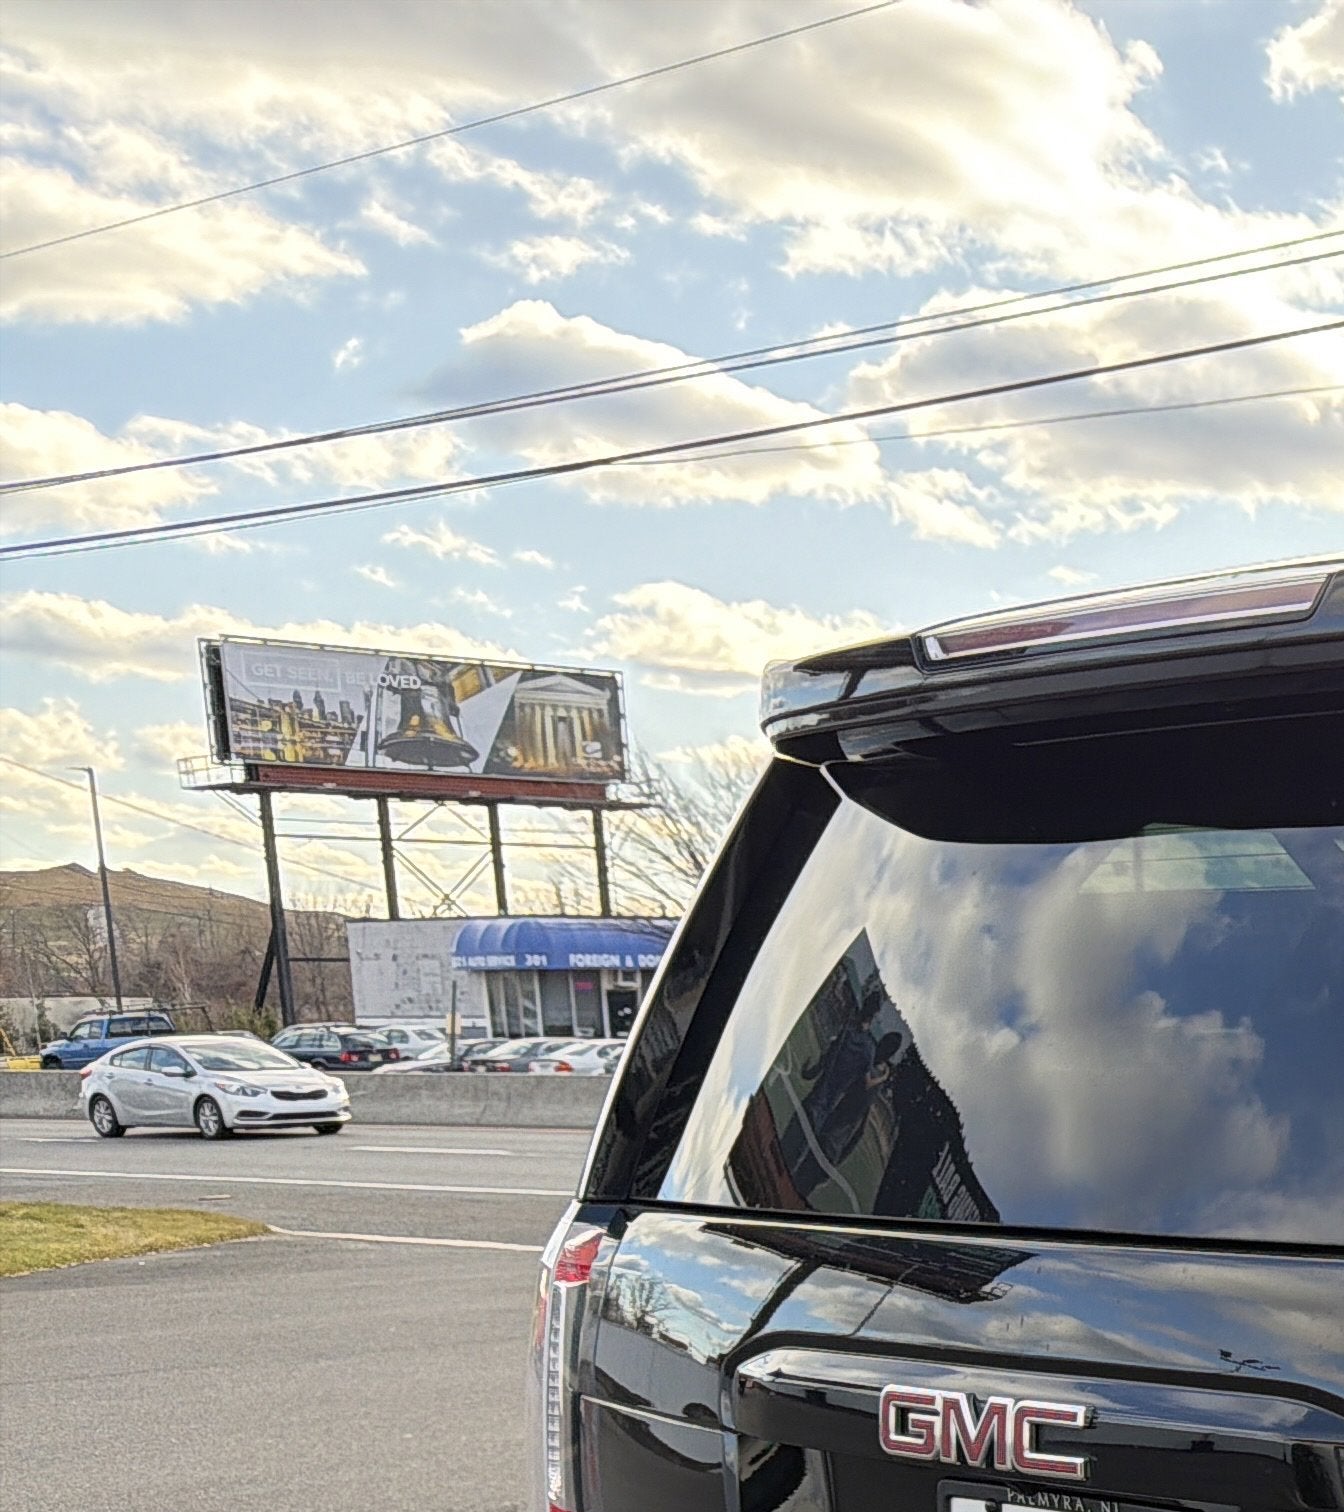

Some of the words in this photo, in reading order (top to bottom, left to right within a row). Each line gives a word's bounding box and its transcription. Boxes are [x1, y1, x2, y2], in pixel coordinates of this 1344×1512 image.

[252, 662, 283, 678] GET
[569, 953, 620, 968] FOREIGN
[879, 1383, 1097, 1481] GMC
